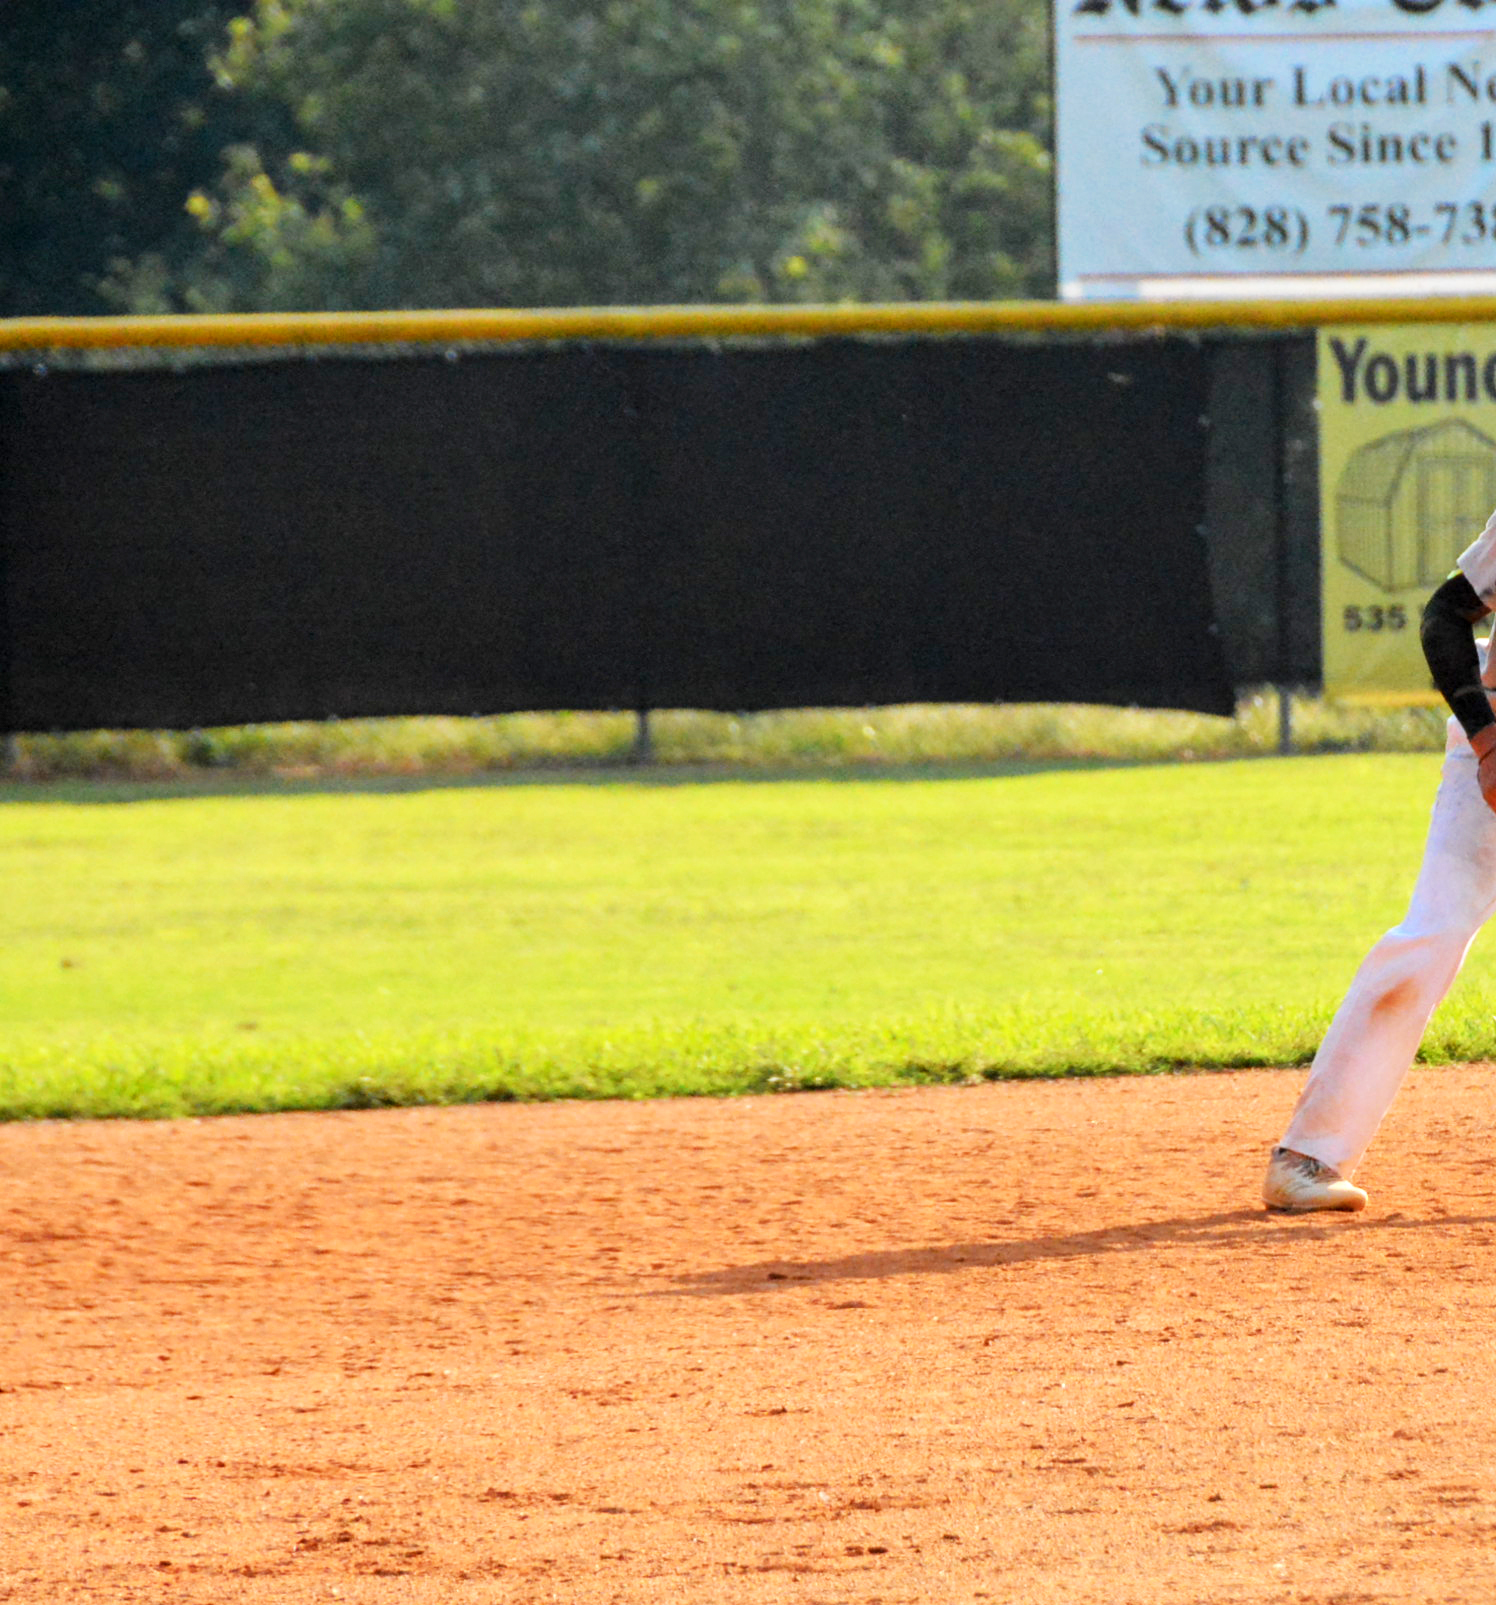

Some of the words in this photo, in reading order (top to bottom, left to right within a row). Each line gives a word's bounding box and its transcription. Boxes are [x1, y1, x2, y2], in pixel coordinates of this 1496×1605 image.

[1156, 67, 1273, 109] Your
[1293, 64, 1426, 107] Local
[1142, 124, 1309, 167] Source
[1327, 121, 1457, 166] Since
[1184, 205, 1309, 256] (828)
